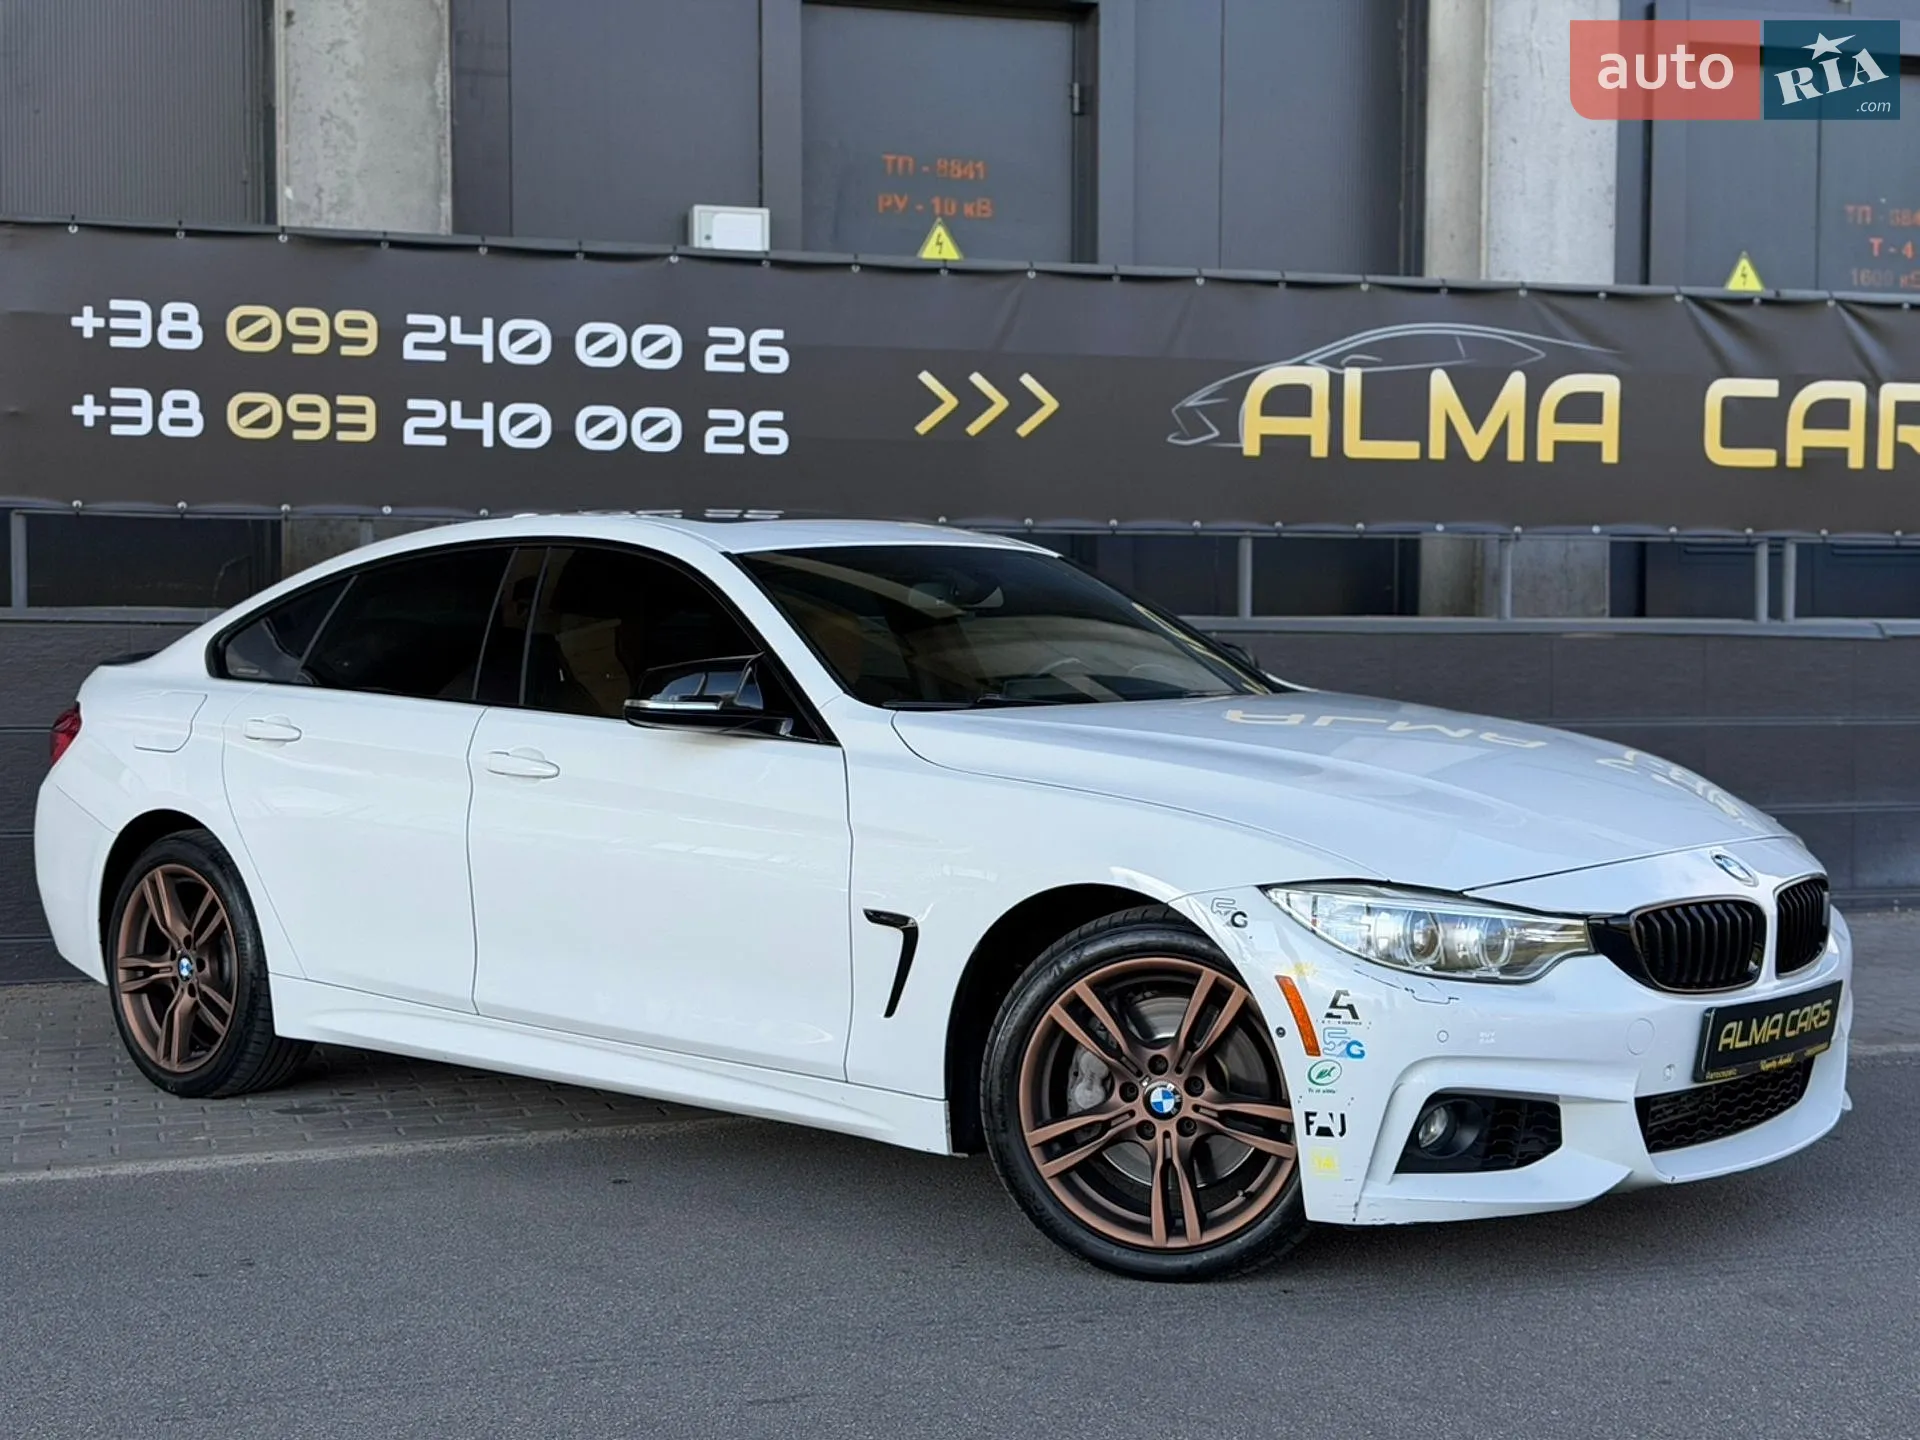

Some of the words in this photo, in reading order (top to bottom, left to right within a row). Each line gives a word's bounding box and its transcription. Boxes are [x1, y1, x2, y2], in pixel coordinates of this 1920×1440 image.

[883, 154, 914, 175] ТП
[878, 193, 908, 213] РУ
[931, 196, 957, 216] 10
[71, 299, 203, 350] +38
[226, 305, 378, 356] 099
[403, 314, 551, 366] 240
[575, 322, 682, 370] 00
[705, 327, 790, 374] 26
[72, 388, 204, 438] +38
[227, 392, 377, 442] 093
[403, 399, 551, 449] 240
[575, 405, 682, 453] 00
[705, 409, 790, 455] 26
[1243, 365, 1621, 464] ALMA
[1717, 1013, 1784, 1052] ALMA
[1785, 999, 1833, 1038] CARS
